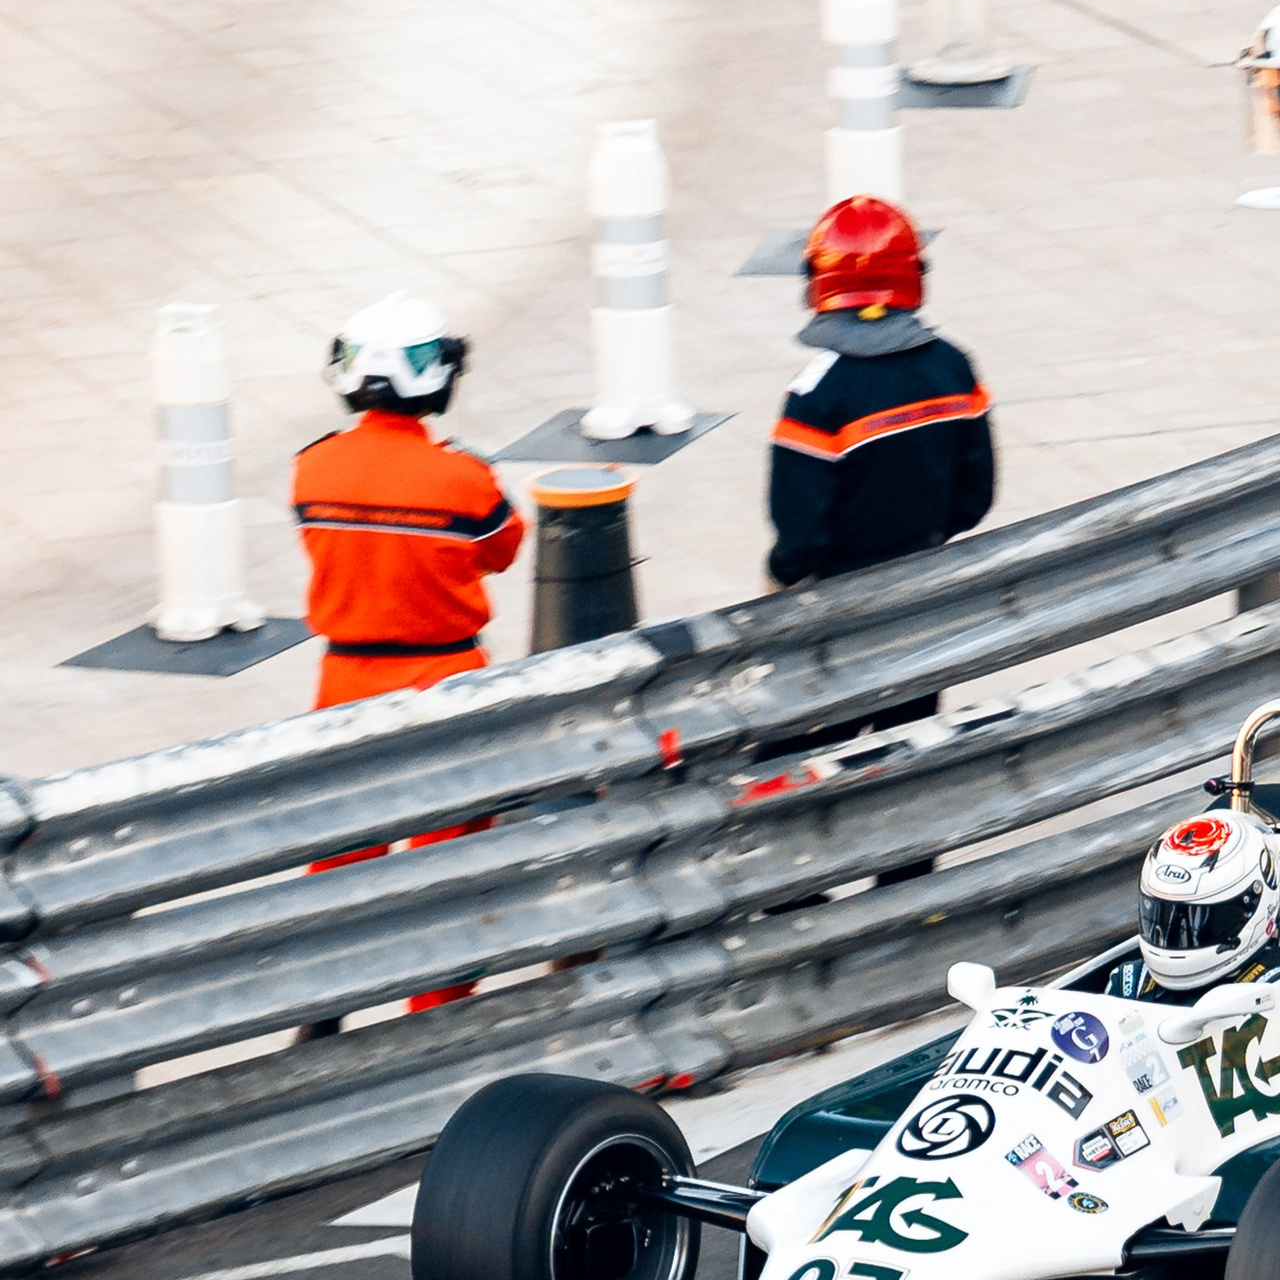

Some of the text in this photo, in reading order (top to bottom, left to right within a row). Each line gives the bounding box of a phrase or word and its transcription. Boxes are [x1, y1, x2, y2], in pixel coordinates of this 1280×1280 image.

[929, 1077, 1020, 1097] aramco
[931, 1046, 1094, 1121] audia
[1132, 1073, 1154, 1095] RACE
[930, 1117, 956, 1136] L
[1013, 1134, 1042, 1161] RACE
[1034, 1160, 1066, 1192] 2
